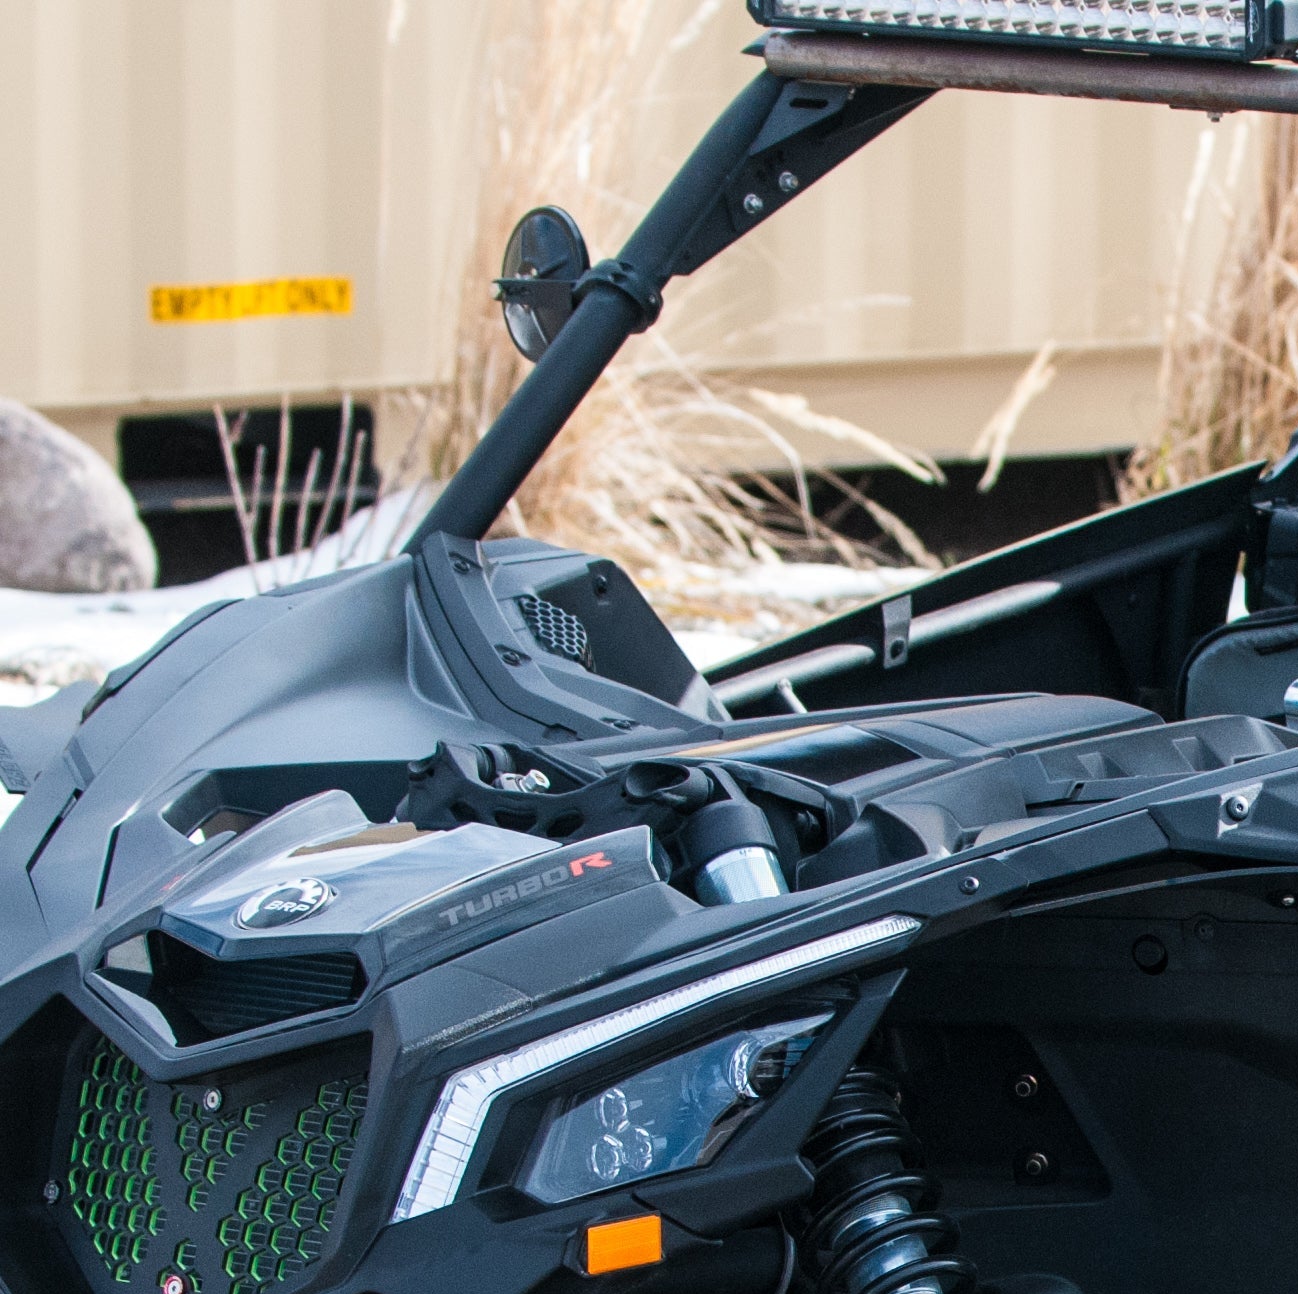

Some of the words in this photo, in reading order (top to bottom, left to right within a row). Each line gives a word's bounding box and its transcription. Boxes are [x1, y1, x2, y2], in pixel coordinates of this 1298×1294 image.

[152, 285, 232, 323] EMPTY
[287, 279, 349, 314] ONLY
[264, 900, 310, 913] BRP
